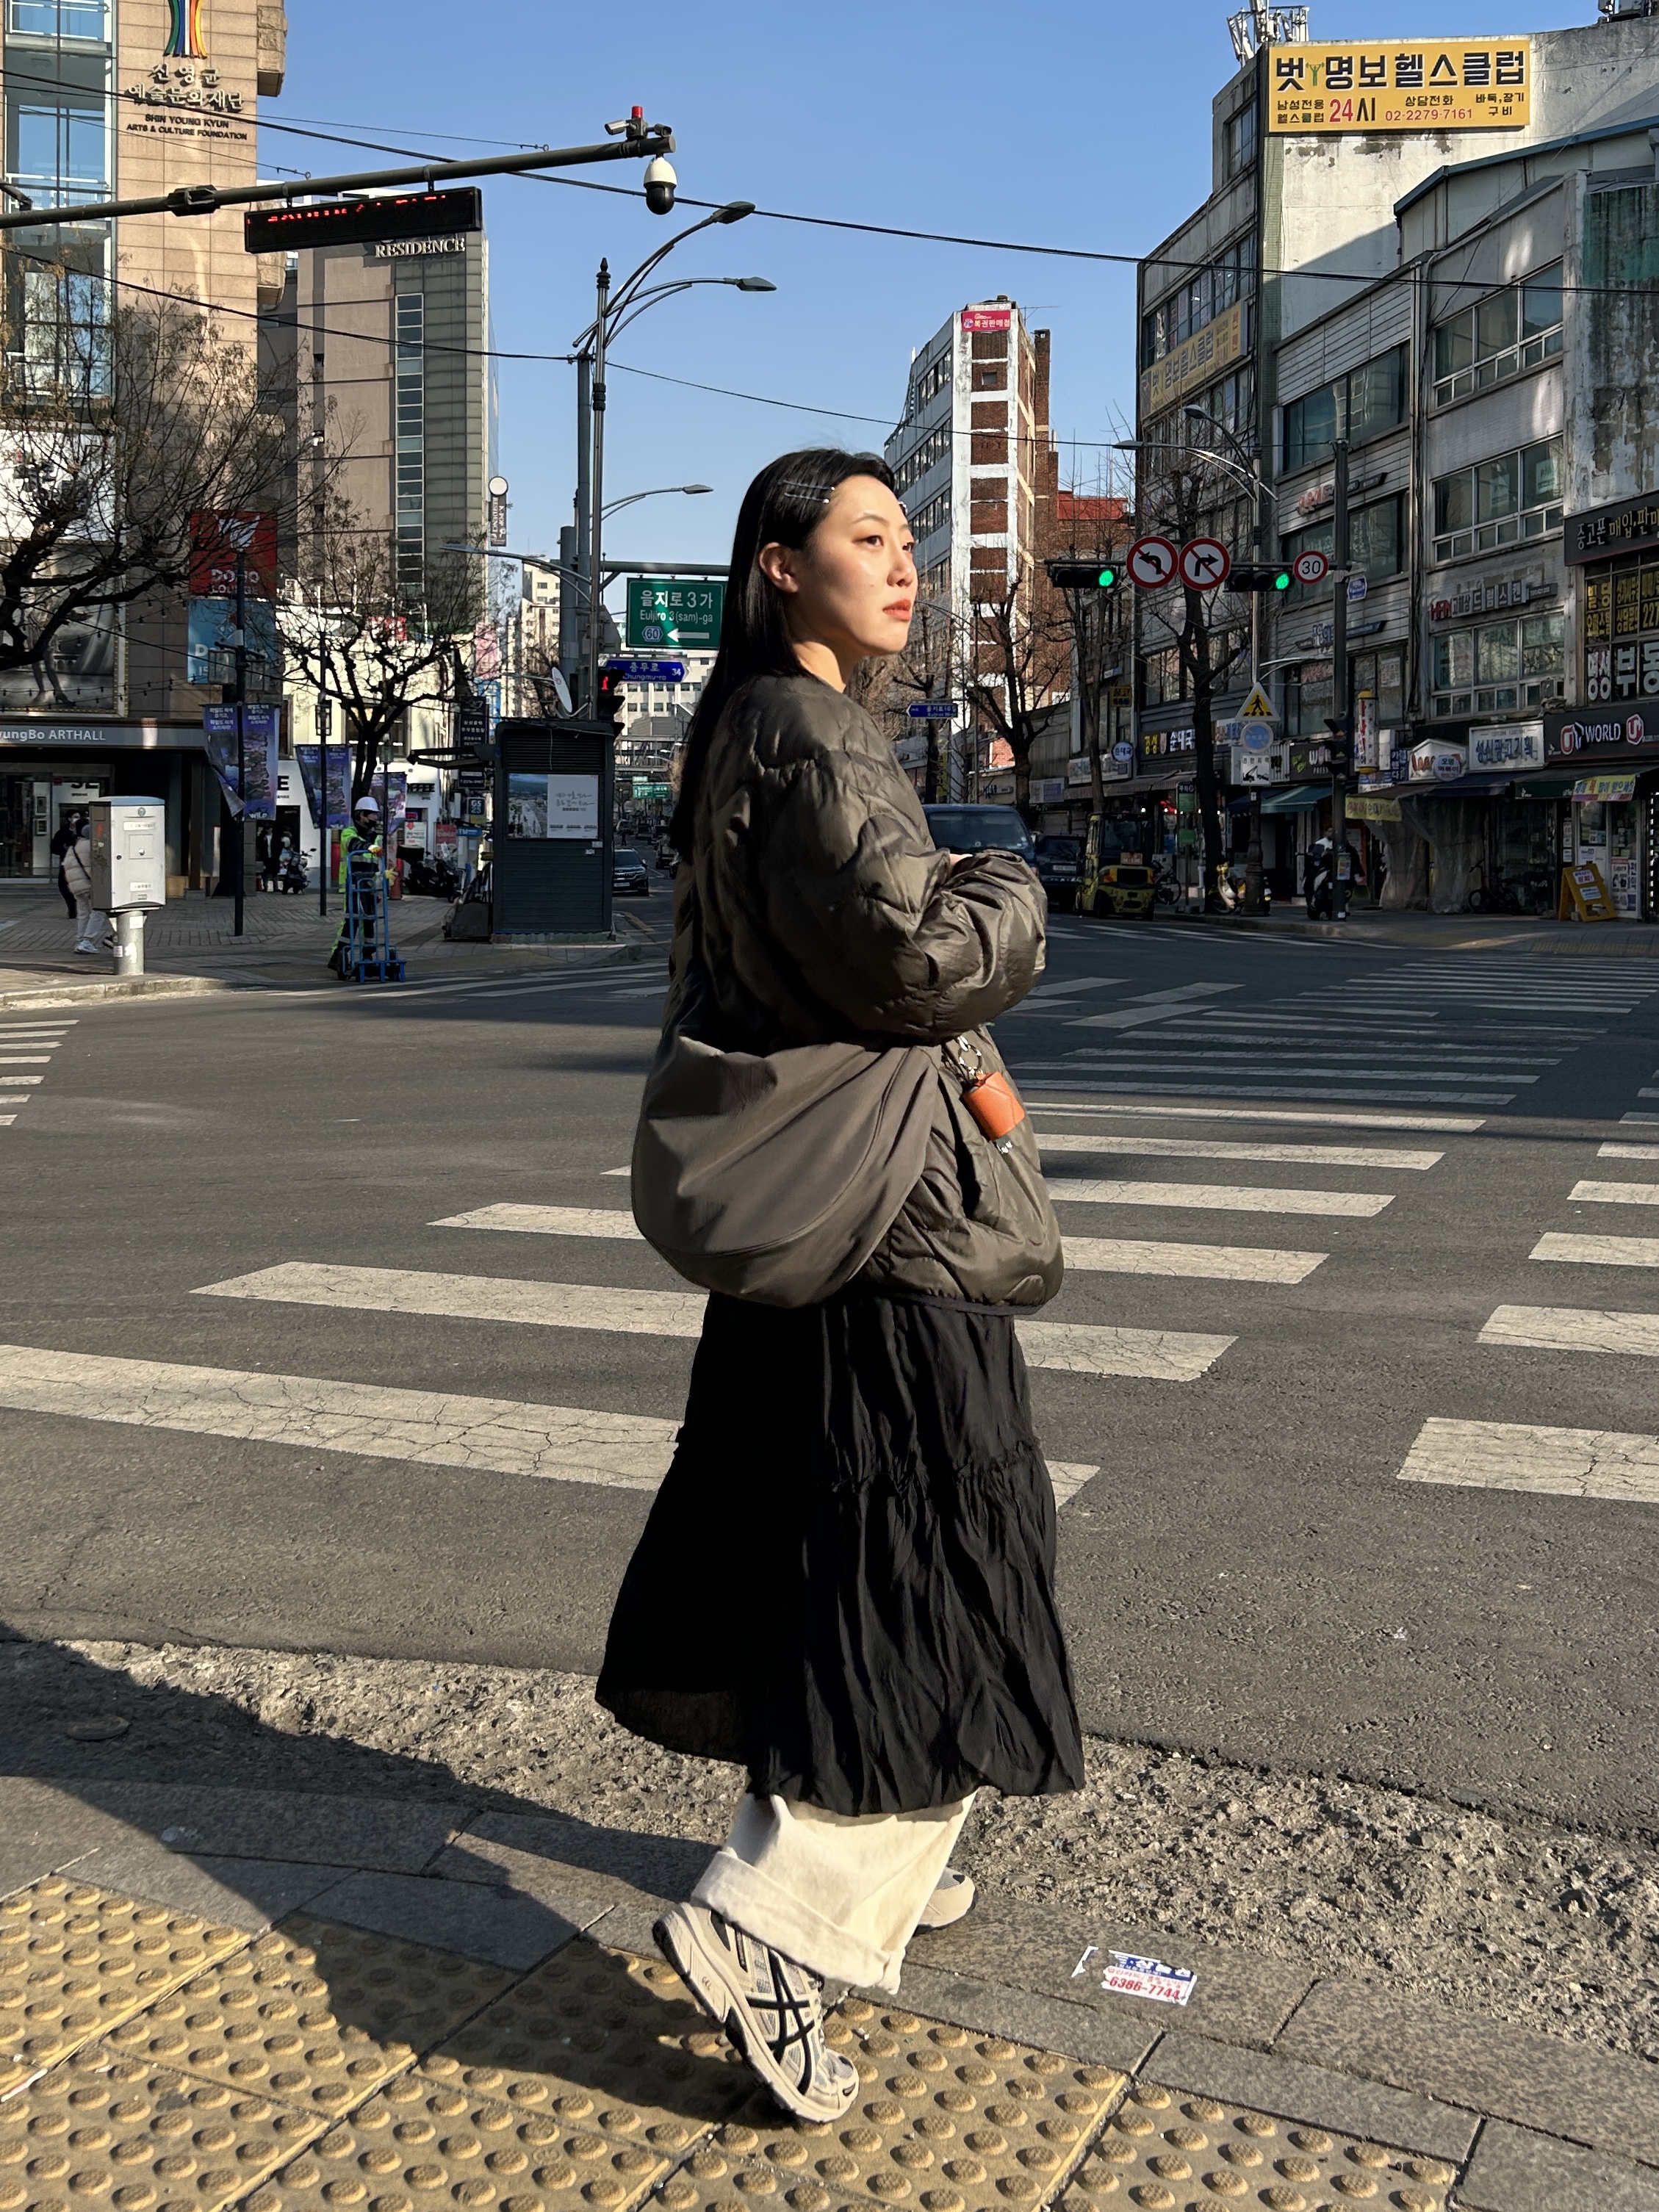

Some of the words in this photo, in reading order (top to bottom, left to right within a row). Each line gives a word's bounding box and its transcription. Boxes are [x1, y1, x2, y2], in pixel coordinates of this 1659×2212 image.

[1325, 51, 1524, 90] 명보헬스클럽
[1277, 99, 1324, 110] 남성전용
[1406, 96, 1454, 107] 상담전화
[1329, 97, 1375, 123] 24시
[1385, 109, 1472, 120] 02-2279-7161
[145, 114, 166, 123] SHIN
[169, 116, 201, 126] YOUNG
[204, 119, 229, 128] KYUN
[1277, 112, 1324, 123] 헬스클럽
[126, 123, 148, 132] ARTS
[159, 126, 195, 136] CULTURE
[198, 130, 247, 140] FOUNDATION
[375, 238, 466, 258] RESIDENCE
[1577, 517, 1607, 550] 중고폰
[1302, 561, 1321, 574] 30
[640, 609, 666, 622] Euljiro
[647, 628, 658, 639] 60
[629, 661, 660, 672] 충무로
[672, 668, 682, 676] 34
[48, 729, 107, 741] ARTHALL
[1585, 723, 1622, 743] WORLD
